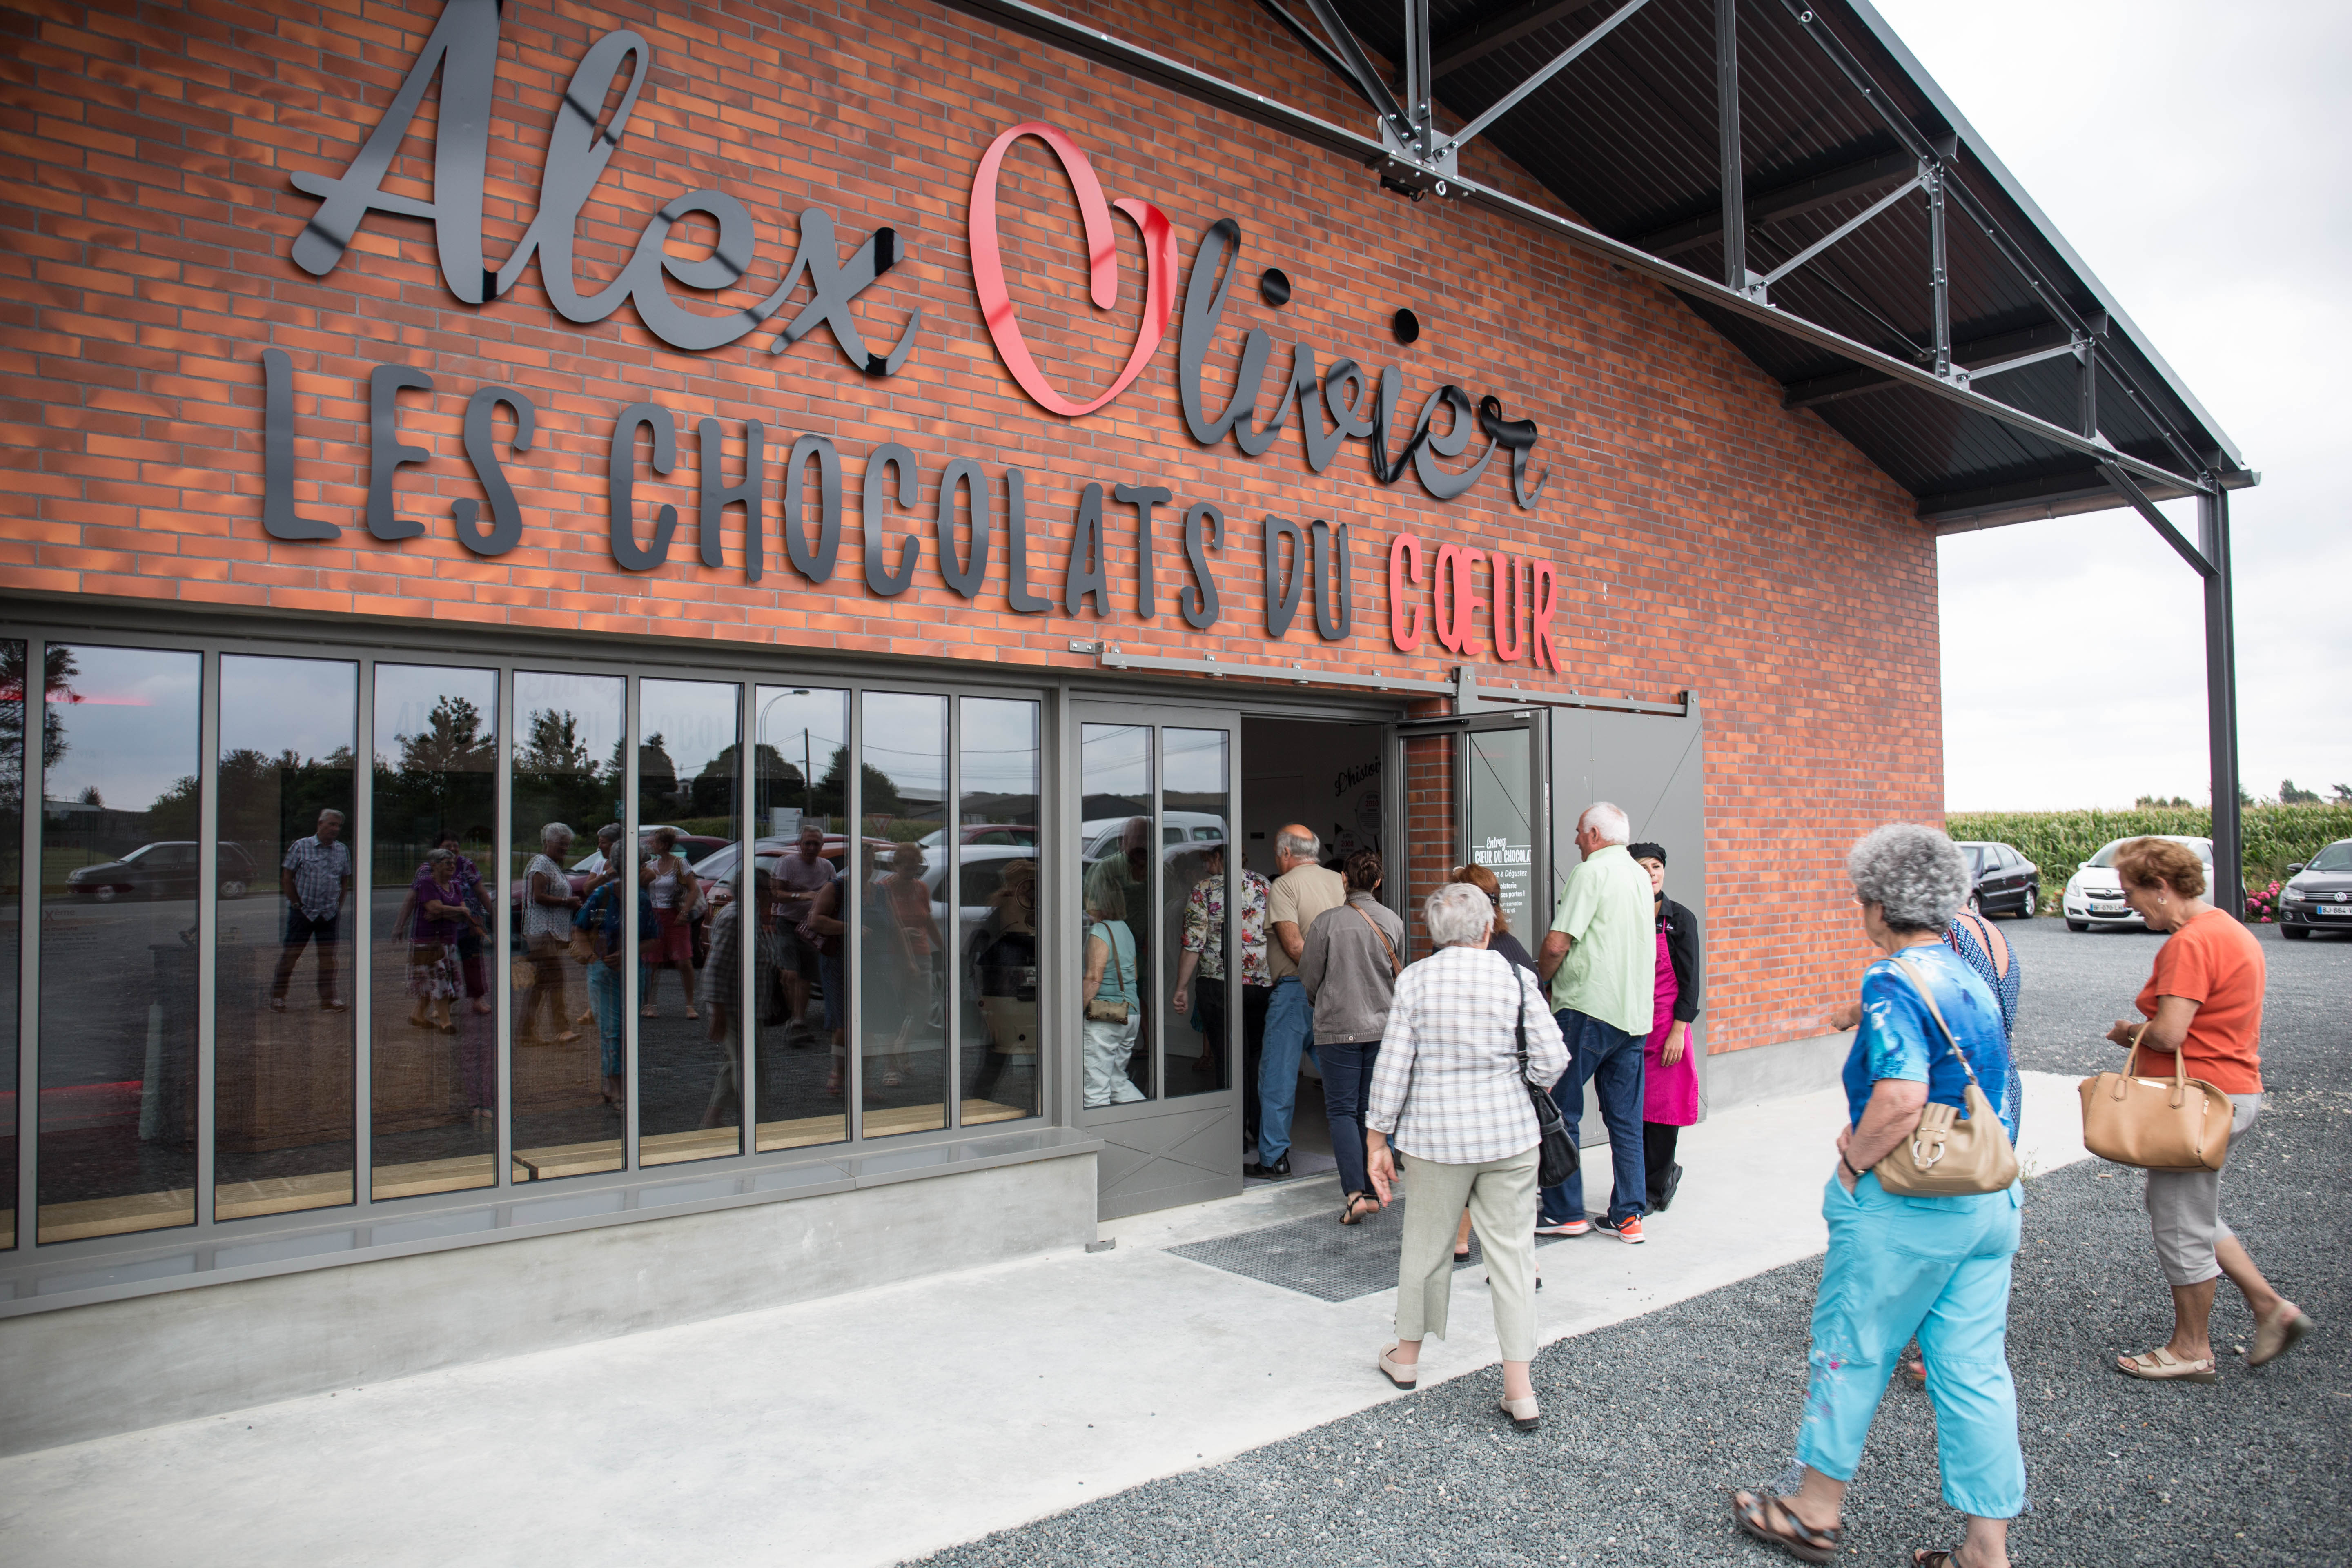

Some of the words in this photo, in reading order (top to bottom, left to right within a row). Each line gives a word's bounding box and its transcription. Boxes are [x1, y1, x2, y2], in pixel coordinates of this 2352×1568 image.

[289, 0, 921, 377] Alex
[969, 121, 1551, 510] Olivier
[262, 347, 535, 557] LES
[610, 402, 1224, 629] CHOCOLATS
[1265, 513, 1352, 640] DU
[1390, 532, 1562, 673] CŒUR
[1486, 837, 1506, 851] Entrez
[1475, 850, 1492, 864] CŒUR
[1494, 850, 1502, 863] DU
[1505, 869, 1527, 878] Dégustez
